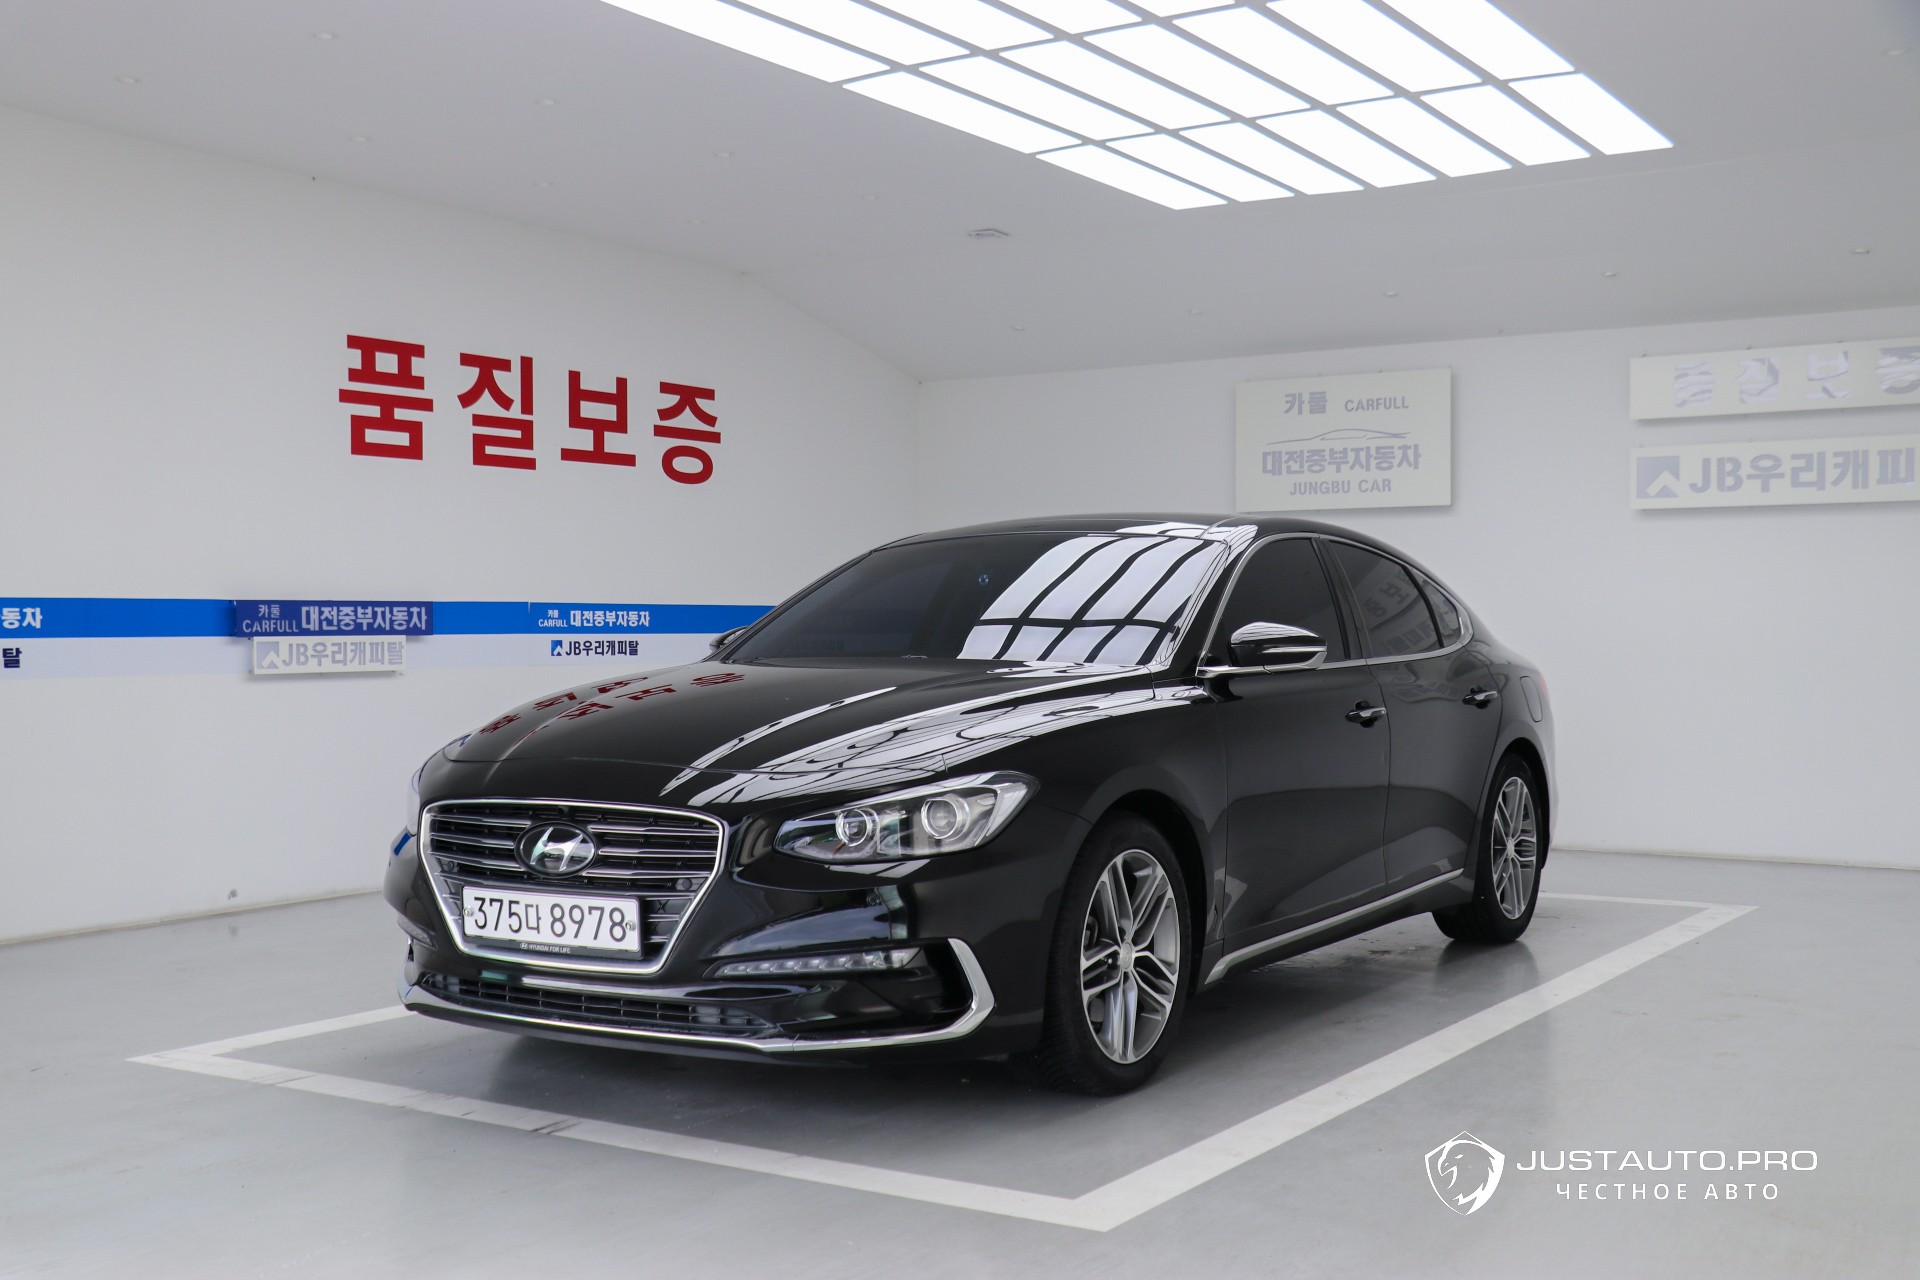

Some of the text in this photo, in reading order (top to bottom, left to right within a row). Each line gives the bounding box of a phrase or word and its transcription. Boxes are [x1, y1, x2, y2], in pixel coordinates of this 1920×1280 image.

[338, 334, 722, 485] 품질보증
[1344, 397, 1410, 413] CARFULL
[1262, 443, 1422, 477] 대전중부자동차
[1289, 478, 1392, 496] JUNGBU CAR
[242, 620, 299, 633] CARFULL
[301, 606, 428, 631] 대전중부자동차
[538, 619, 568, 628] CARFULL
[570, 610, 650, 628] 대전중부자동차
[282, 641, 405, 668] JB우리캐피탈
[565, 640, 639, 657] JB우리캐피탈
